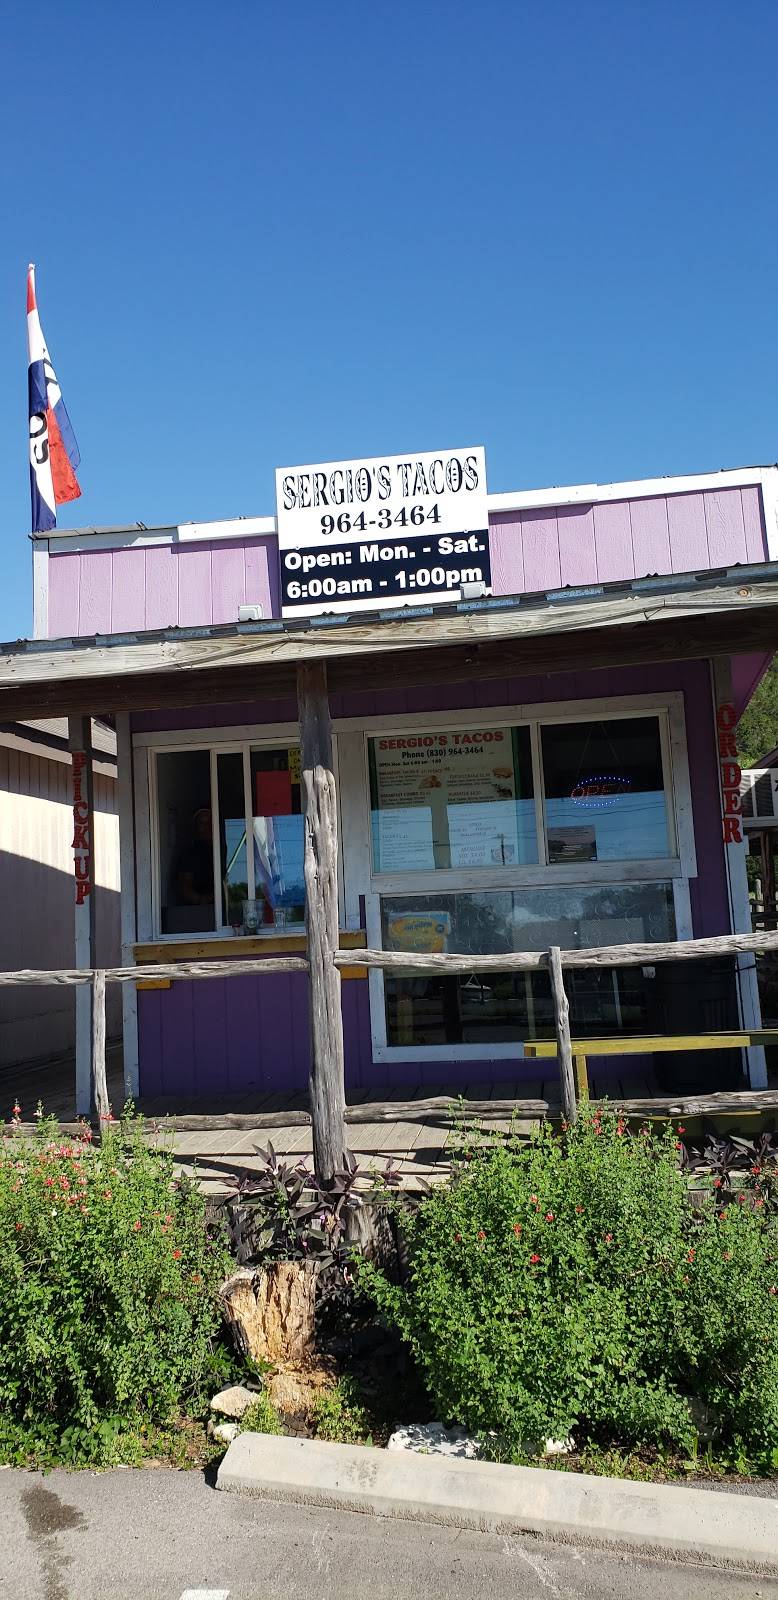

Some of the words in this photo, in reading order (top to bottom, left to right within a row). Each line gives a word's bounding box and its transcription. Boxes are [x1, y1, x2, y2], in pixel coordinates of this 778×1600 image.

[283, 465, 392, 510] SERGIO'S
[397, 456, 479, 498] TACOS
[320, 503, 442, 535] 964-3464
[284, 550, 352, 572] Open:
[360, 543, 416, 563] Mon.
[438, 535, 486, 555] Sat.
[286, 577, 373, 599] 6:00am
[395, 567, 483, 588] 1:00pm
[379, 735, 448, 751] SERGIO'S
[452, 731, 504, 746] TACOS
[402, 751, 425, 759] Phone
[426, 748, 447, 759] (830)
[717, 703, 743, 843] ORDER
